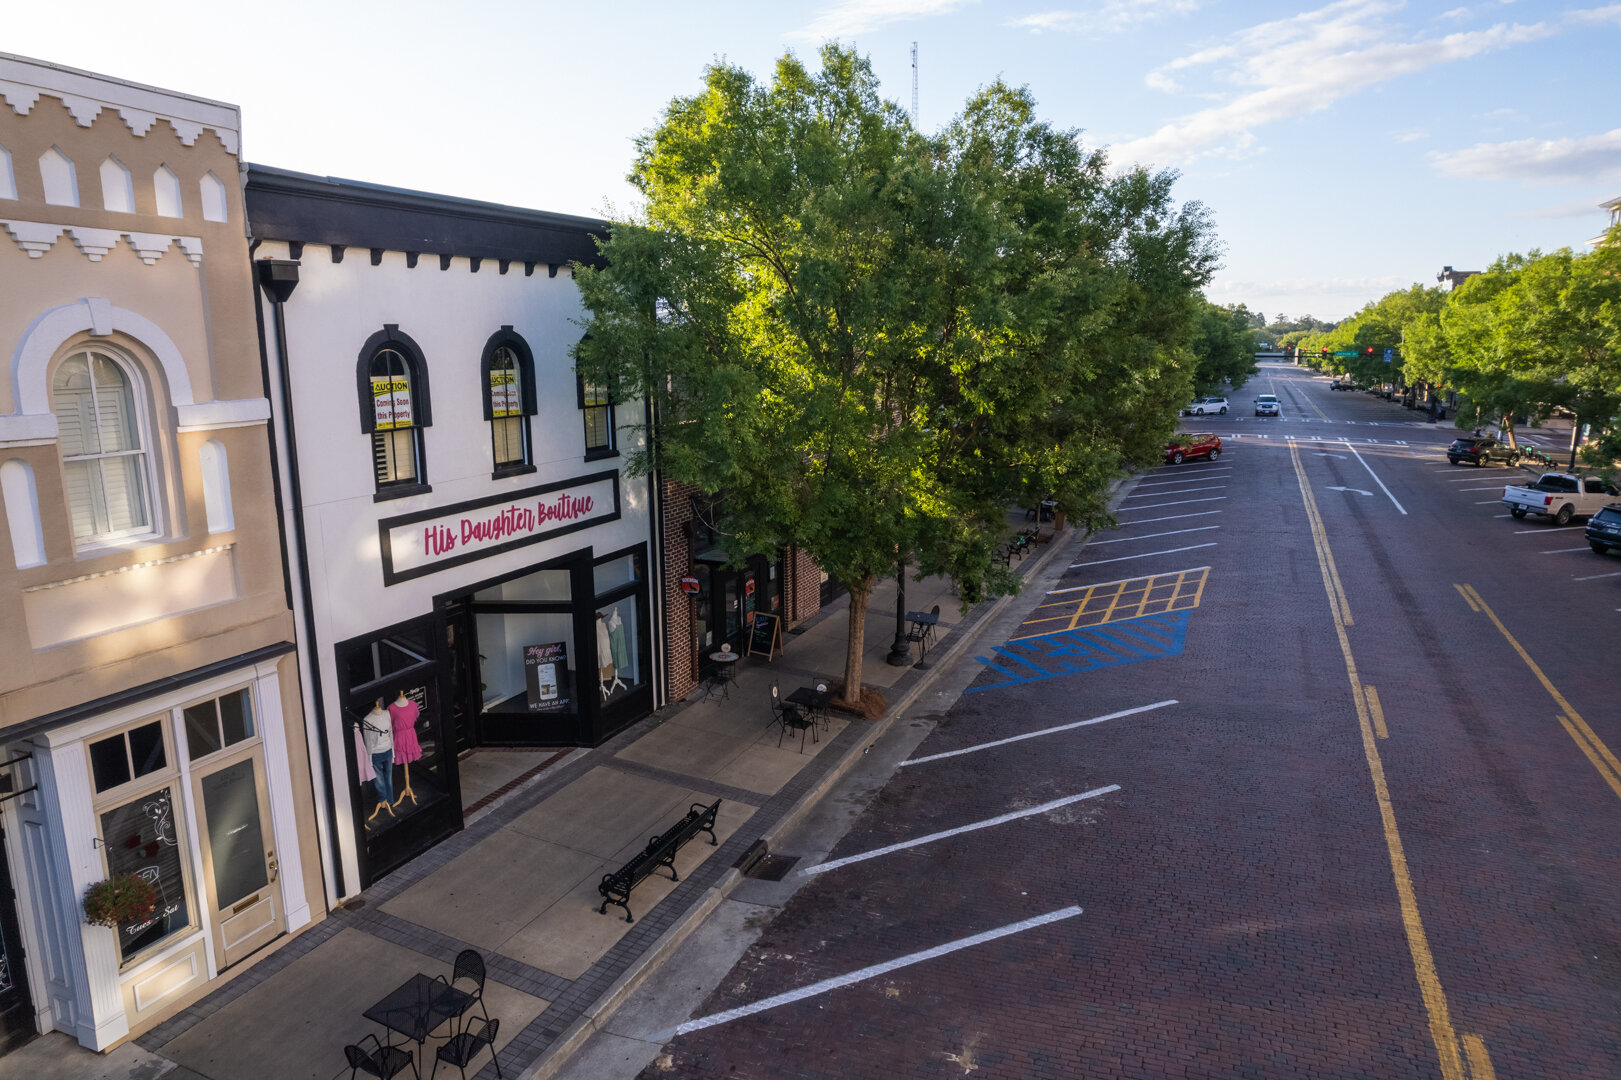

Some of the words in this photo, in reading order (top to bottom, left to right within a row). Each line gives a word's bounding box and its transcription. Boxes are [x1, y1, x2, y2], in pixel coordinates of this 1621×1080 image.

[396, 398, 409, 406] Soon
[377, 411, 387, 420] this
[424, 524, 458, 556] His
[461, 505, 535, 545] Daughter
[537, 493, 594, 526] Boutique
[529, 646, 544, 658] Hey
[126, 919, 152, 935] Tues
[163, 904, 180, 918] Sat
